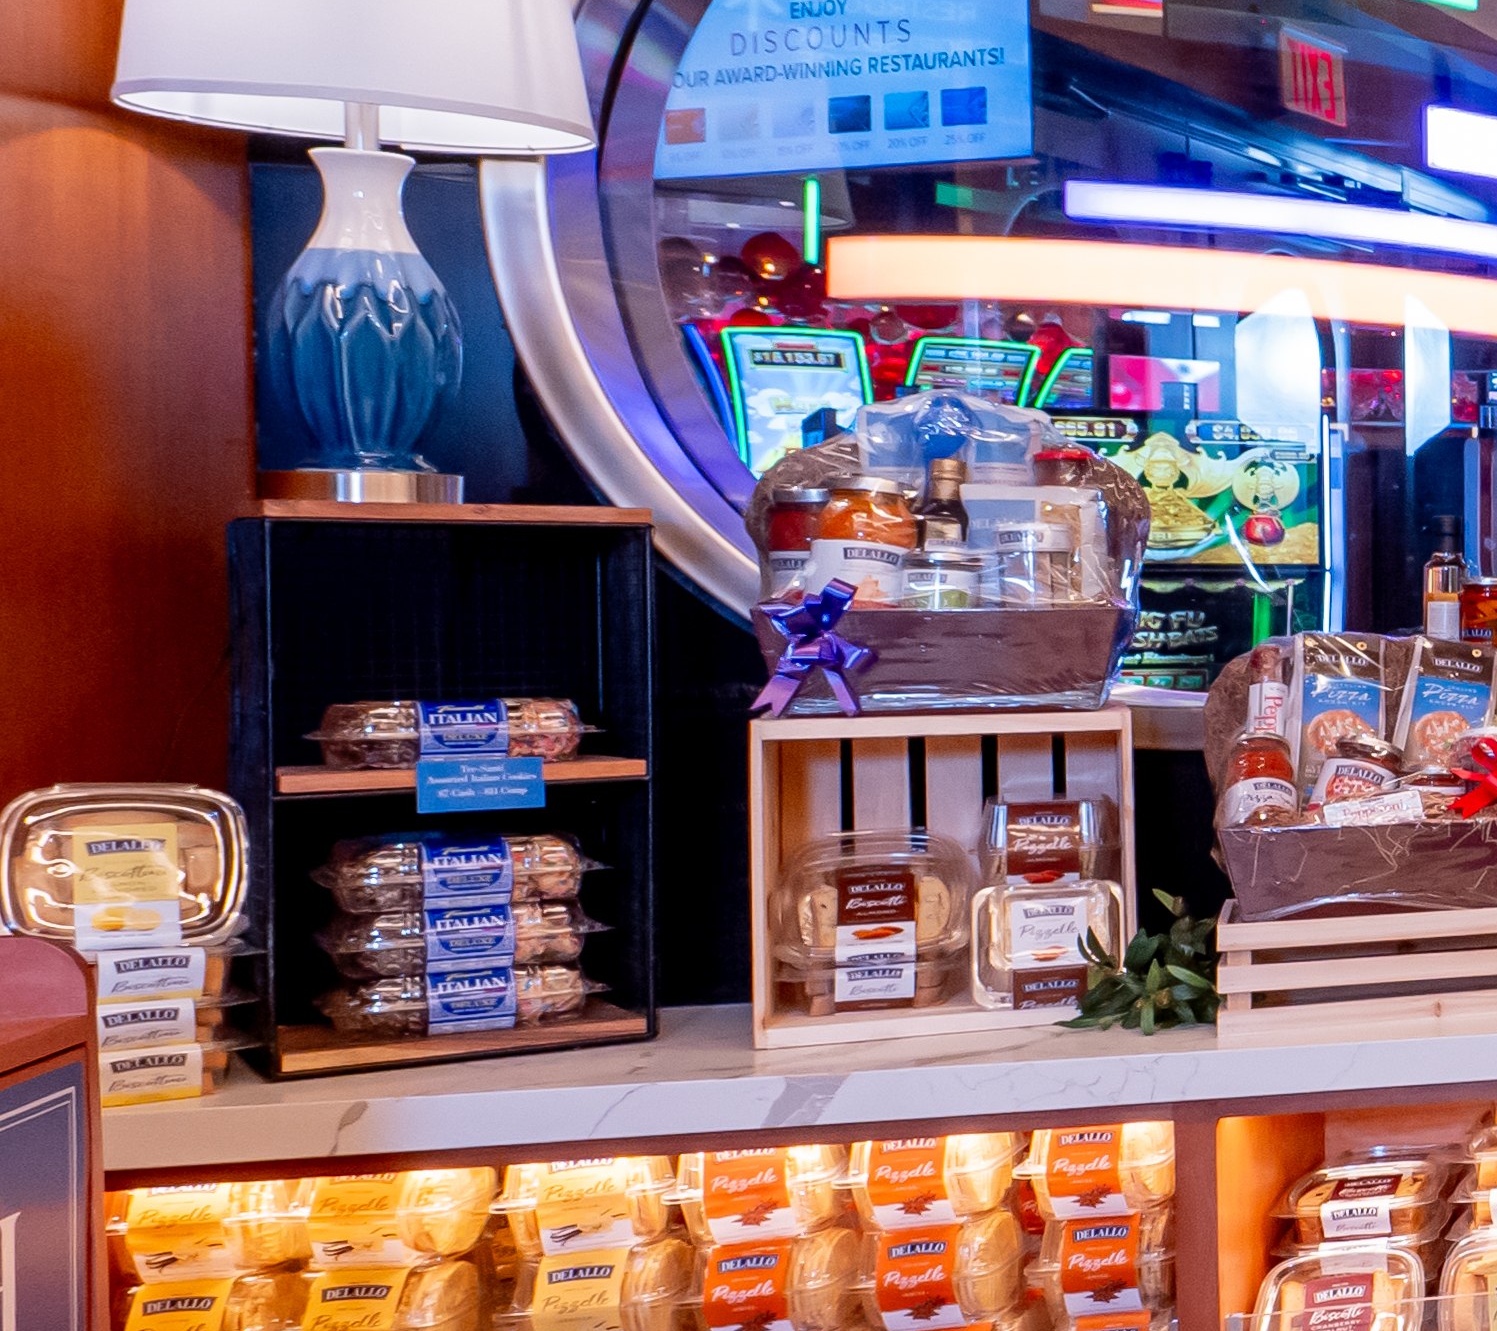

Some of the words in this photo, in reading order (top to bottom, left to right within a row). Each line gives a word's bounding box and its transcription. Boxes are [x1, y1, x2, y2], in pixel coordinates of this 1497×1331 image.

[790, 0, 847, 19] ENJOY
[731, 19, 911, 56] DISCOUNTS
[673, 71, 708, 88] OUR
[715, 59, 861, 86] AWARD-WINNING
[869, 47, 1004, 74] RESTAURANTS!
[844, 547, 899, 565] DELALLO
[1434, 657, 1482, 673] DELALLO
[1422, 682, 1480, 706] Pizza
[428, 713, 497, 724] ITALIAN
[1018, 920, 1079, 942] Pizzelle
[114, 955, 191, 973] DELALLO
[436, 977, 505, 992] ITALIAN
[882, 1136, 938, 1154] DELALLO
[543, 1180, 616, 1203] Pizzelle
[138, 1205, 214, 1224] Pizzelle
[548, 1264, 615, 1284] DELALLO
[1314, 1285, 1366, 1303] DELALLO
[1309, 1304, 1364, 1325] Biscotti
[1311, 1319, 1361, 1331] CRANBERRY
